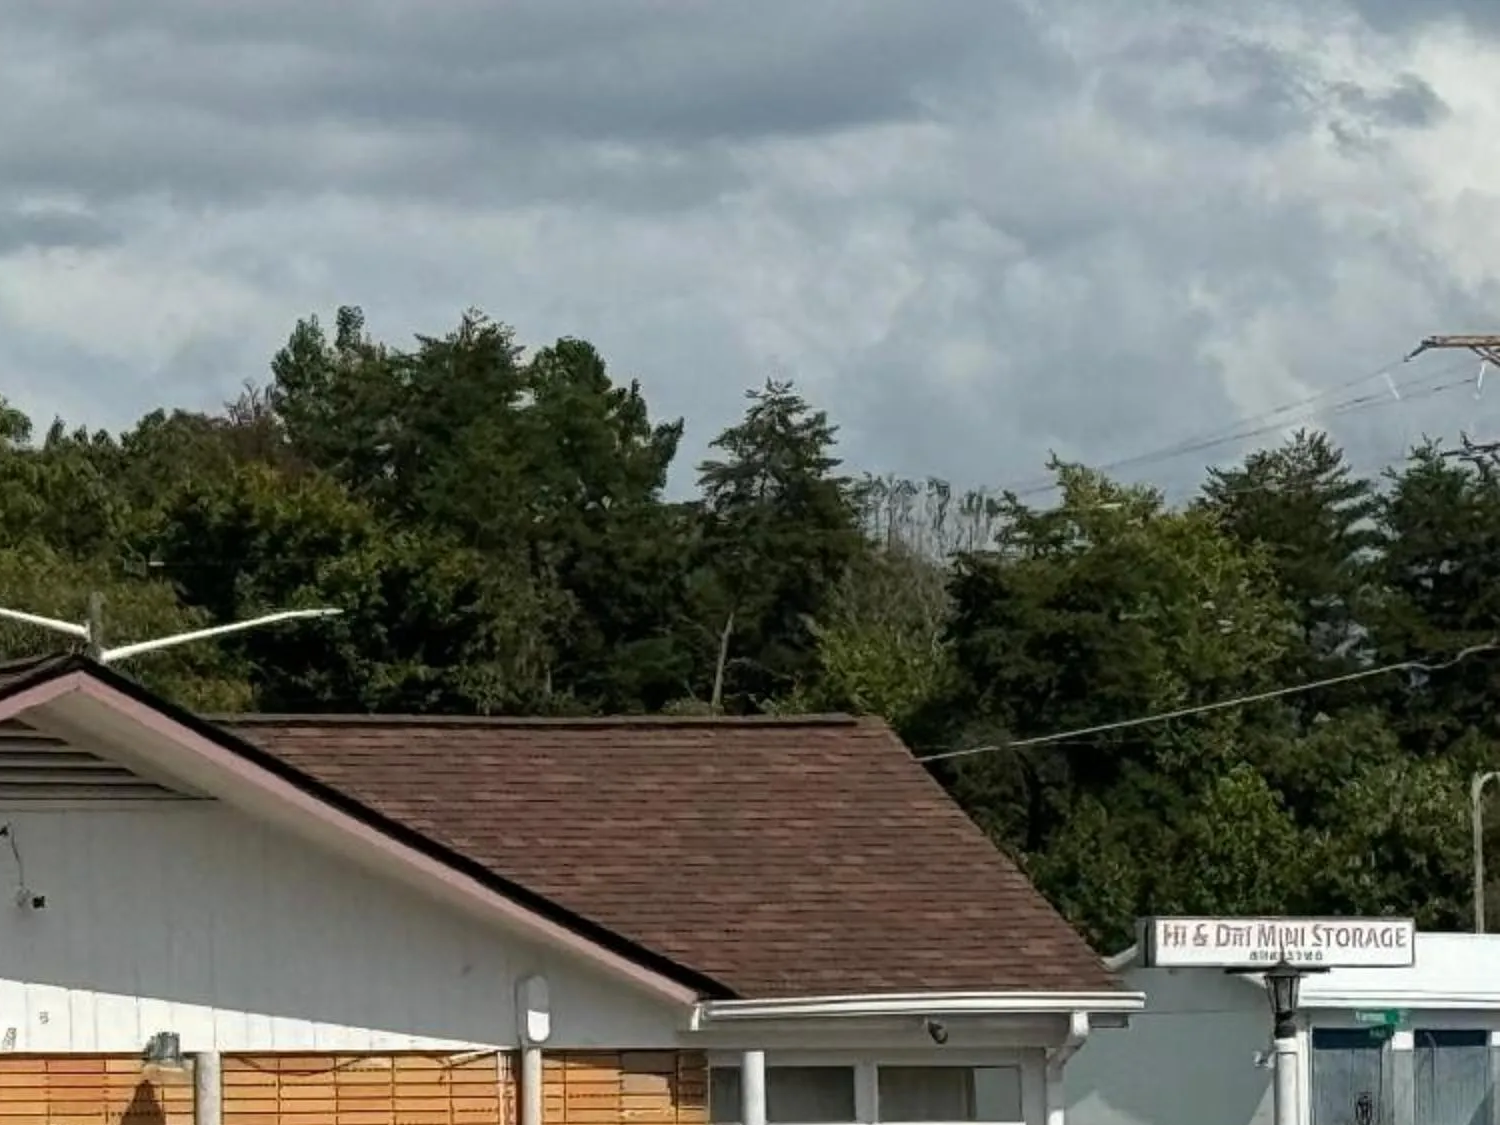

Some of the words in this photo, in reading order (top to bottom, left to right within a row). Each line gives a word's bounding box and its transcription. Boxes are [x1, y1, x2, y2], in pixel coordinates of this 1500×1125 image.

[1192, 922, 1209, 948] &
[1257, 922, 1306, 949] MINI
[1310, 922, 1407, 949] STORAGE
